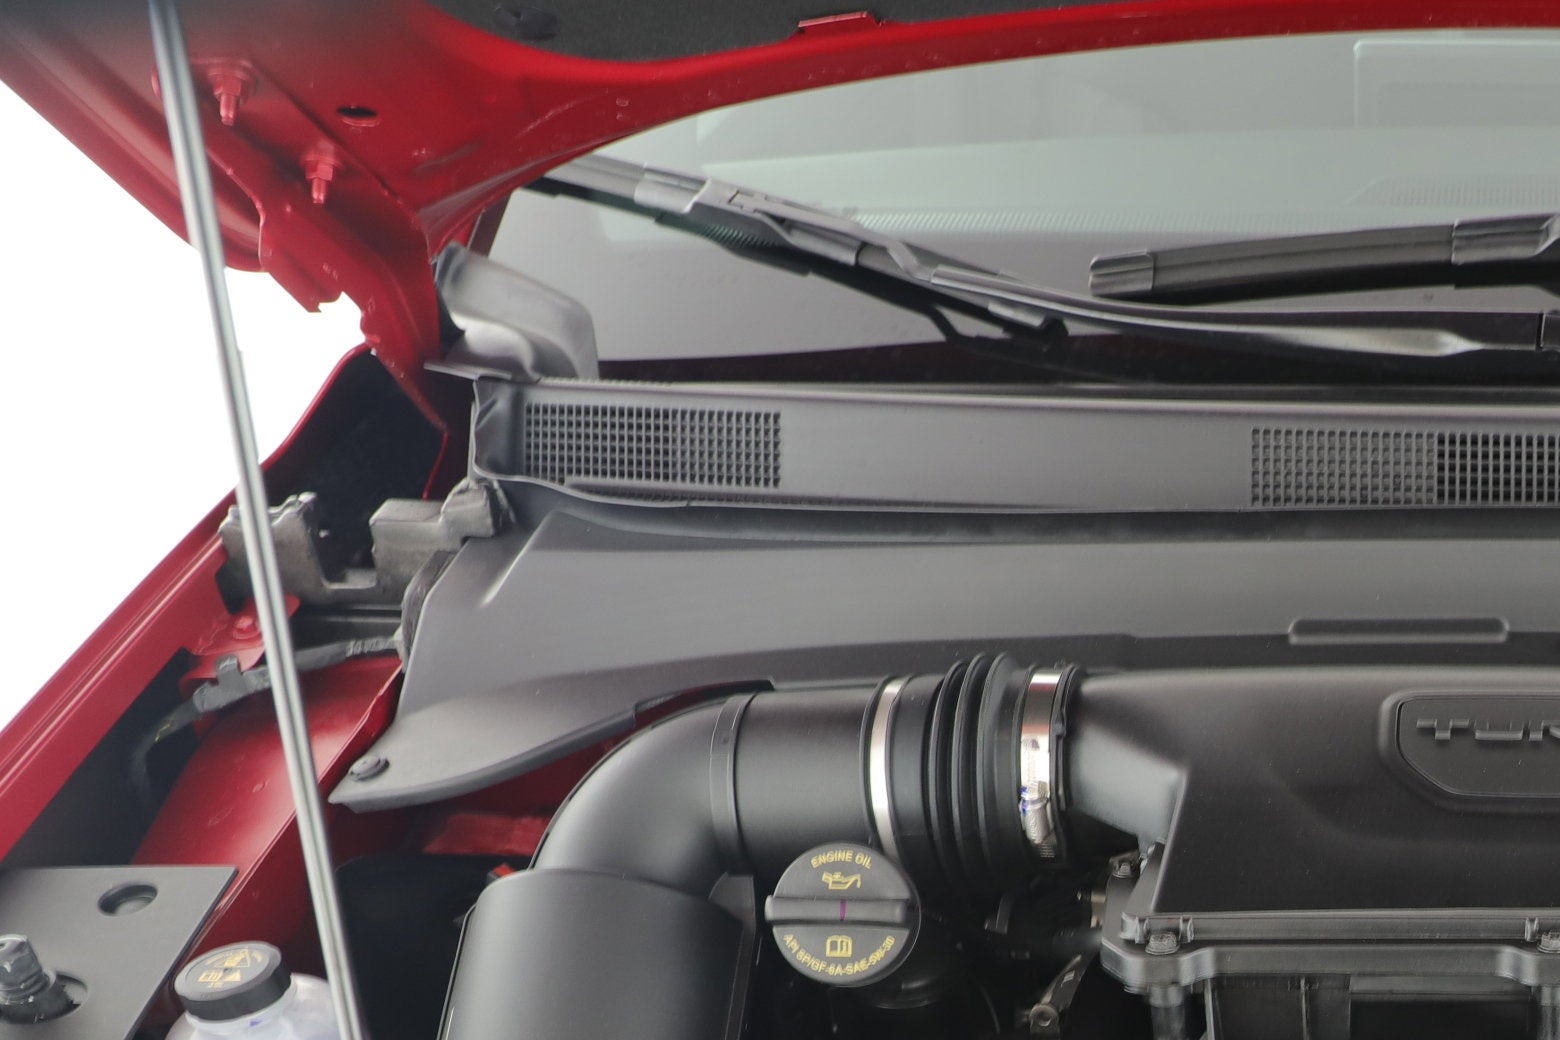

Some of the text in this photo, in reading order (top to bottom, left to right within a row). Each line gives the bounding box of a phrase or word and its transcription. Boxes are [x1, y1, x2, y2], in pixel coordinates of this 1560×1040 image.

[810, 850, 873, 869] ENGINE OIL
[783, 933, 799, 954] API
